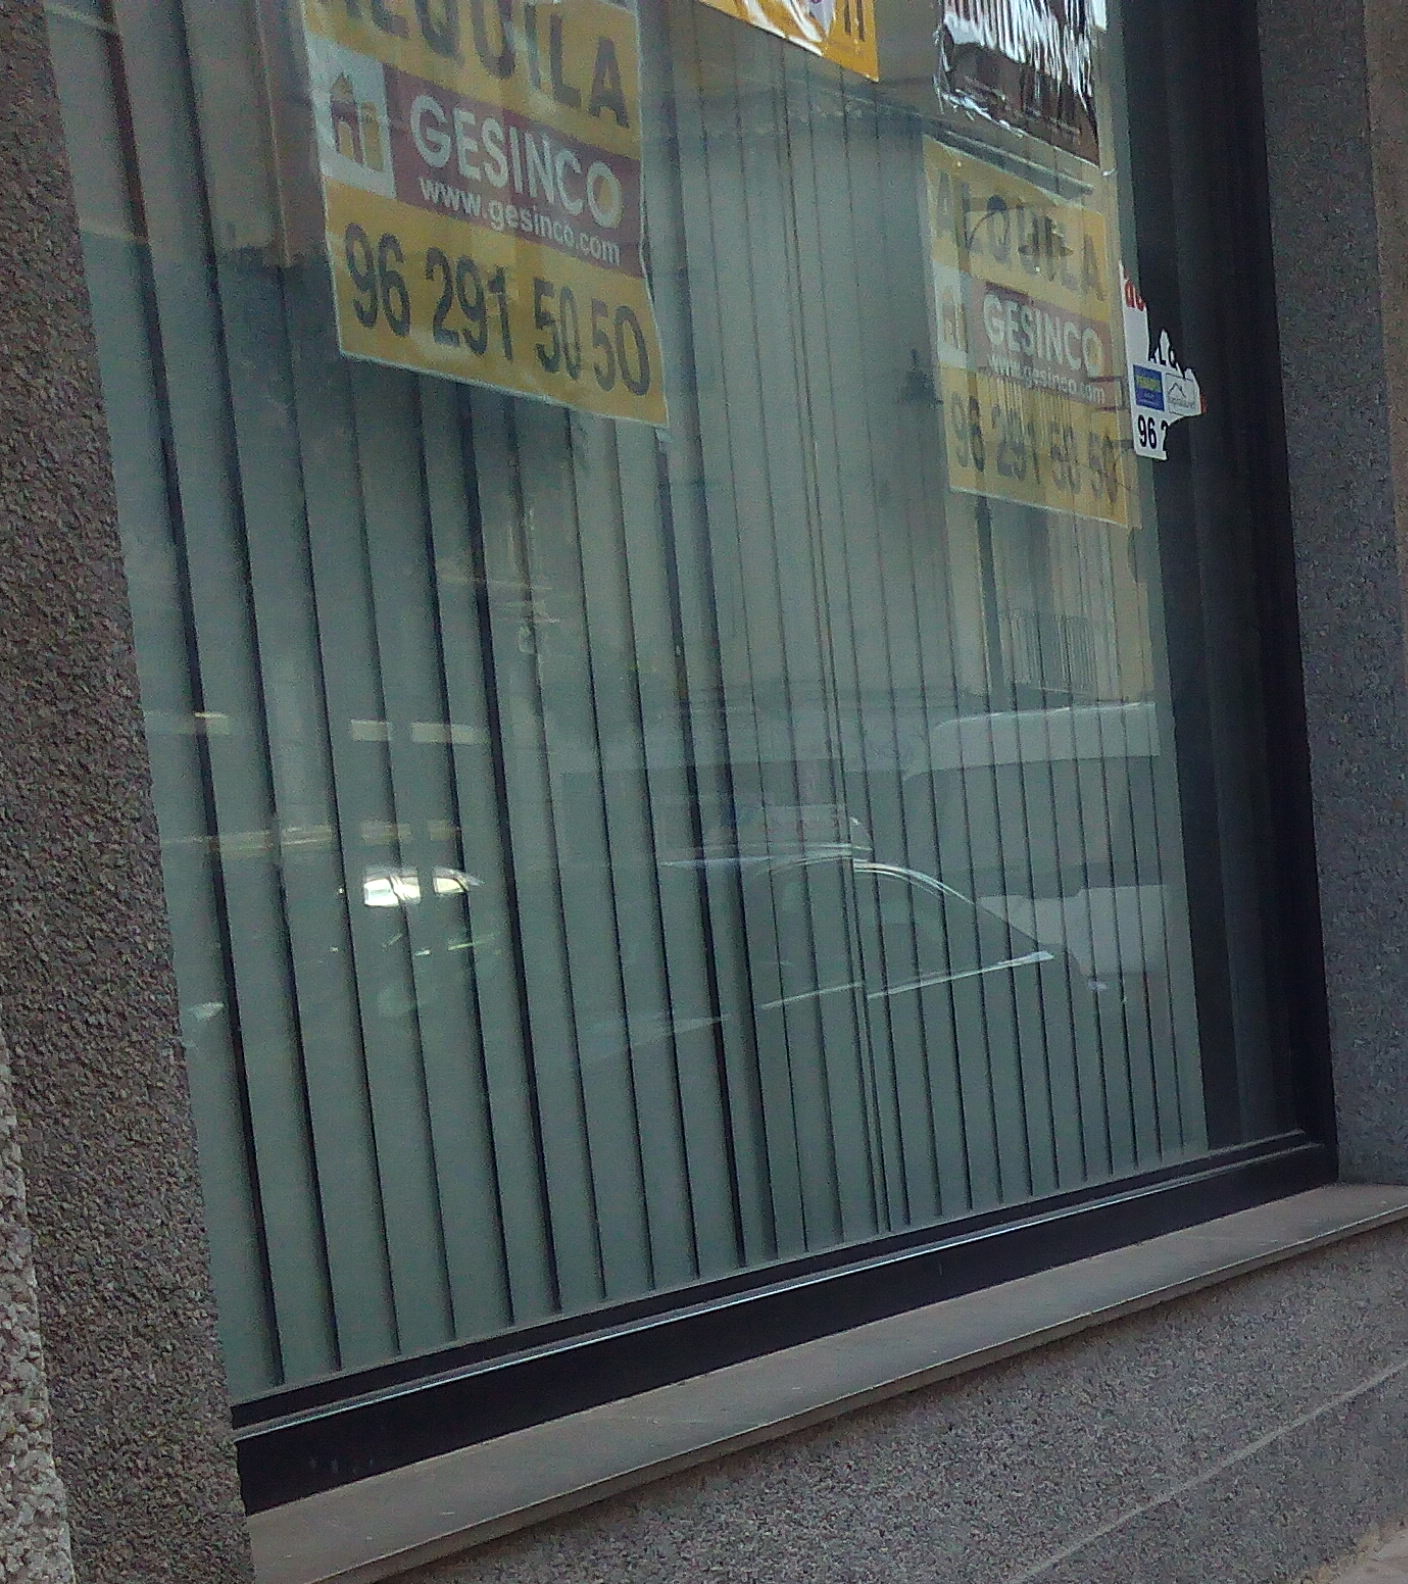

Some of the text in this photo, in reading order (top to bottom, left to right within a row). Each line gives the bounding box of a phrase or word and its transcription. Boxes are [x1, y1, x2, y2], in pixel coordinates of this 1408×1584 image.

[344, 0, 630, 129] QUILA
[410, 94, 624, 229] GESINCO
[419, 176, 621, 267] www.gesinco.com
[345, 222, 650, 397] 96 291 50 50
[983, 294, 1103, 378] GESINCO
[1137, 414, 1157, 450] 96
